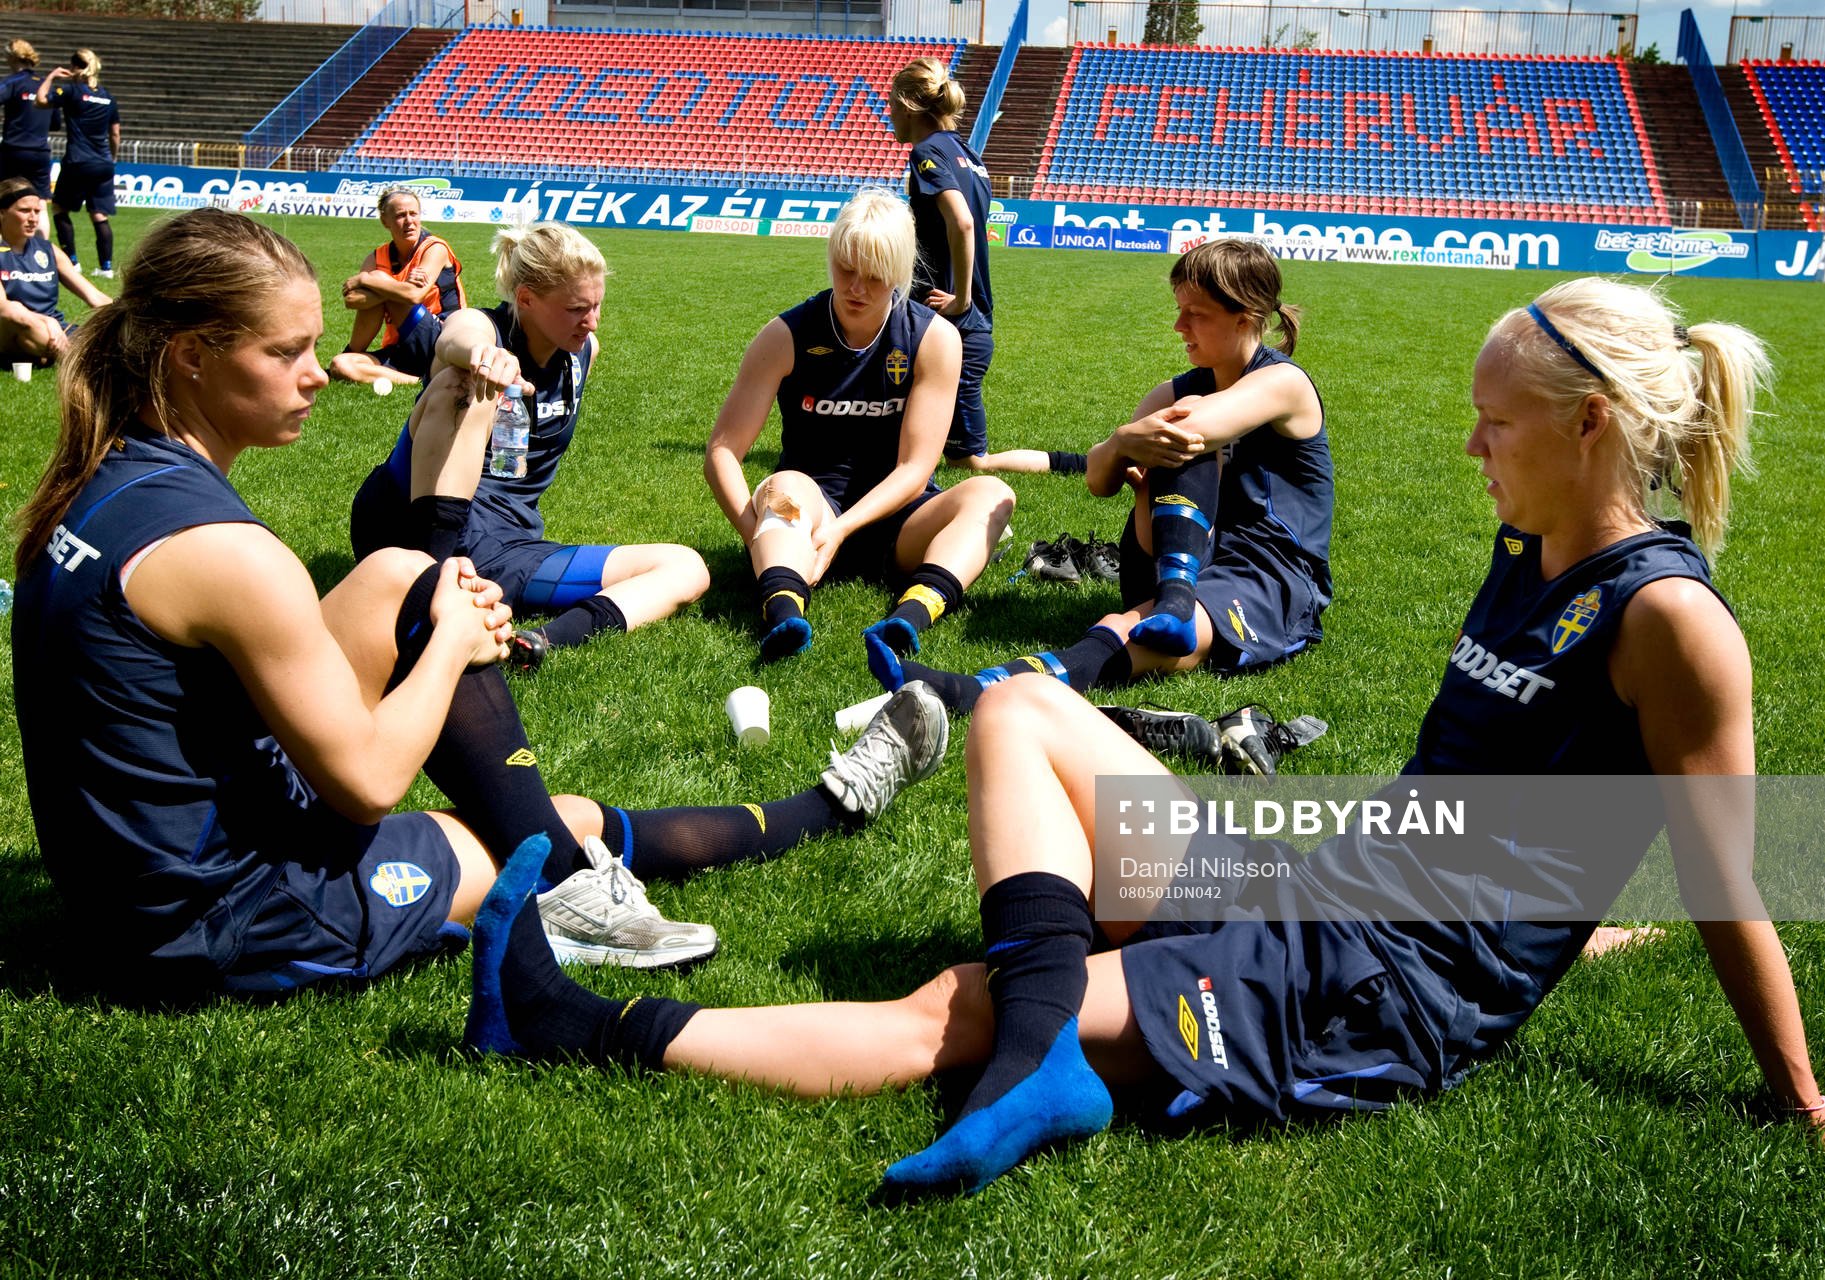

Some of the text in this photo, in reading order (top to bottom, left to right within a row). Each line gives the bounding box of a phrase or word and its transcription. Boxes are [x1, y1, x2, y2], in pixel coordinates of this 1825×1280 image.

[1093, 68, 1604, 158] FEHÉRVÁR
[636, 194, 709, 226] AZ
[719, 189, 848, 221] ÉLET
[696, 218, 755, 233] BORSODI
[1055, 234, 1107, 248] UNIQA
[1345, 247, 1511, 266] www.rexfontana.hu
[1598, 230, 1747, 256] bet-at-home.com
[815, 398, 906, 417] ODDSET
[46, 524, 102, 573] SET
[1450, 635, 1556, 705] ODDSET
[1201, 991, 1229, 1070] ODDSET
